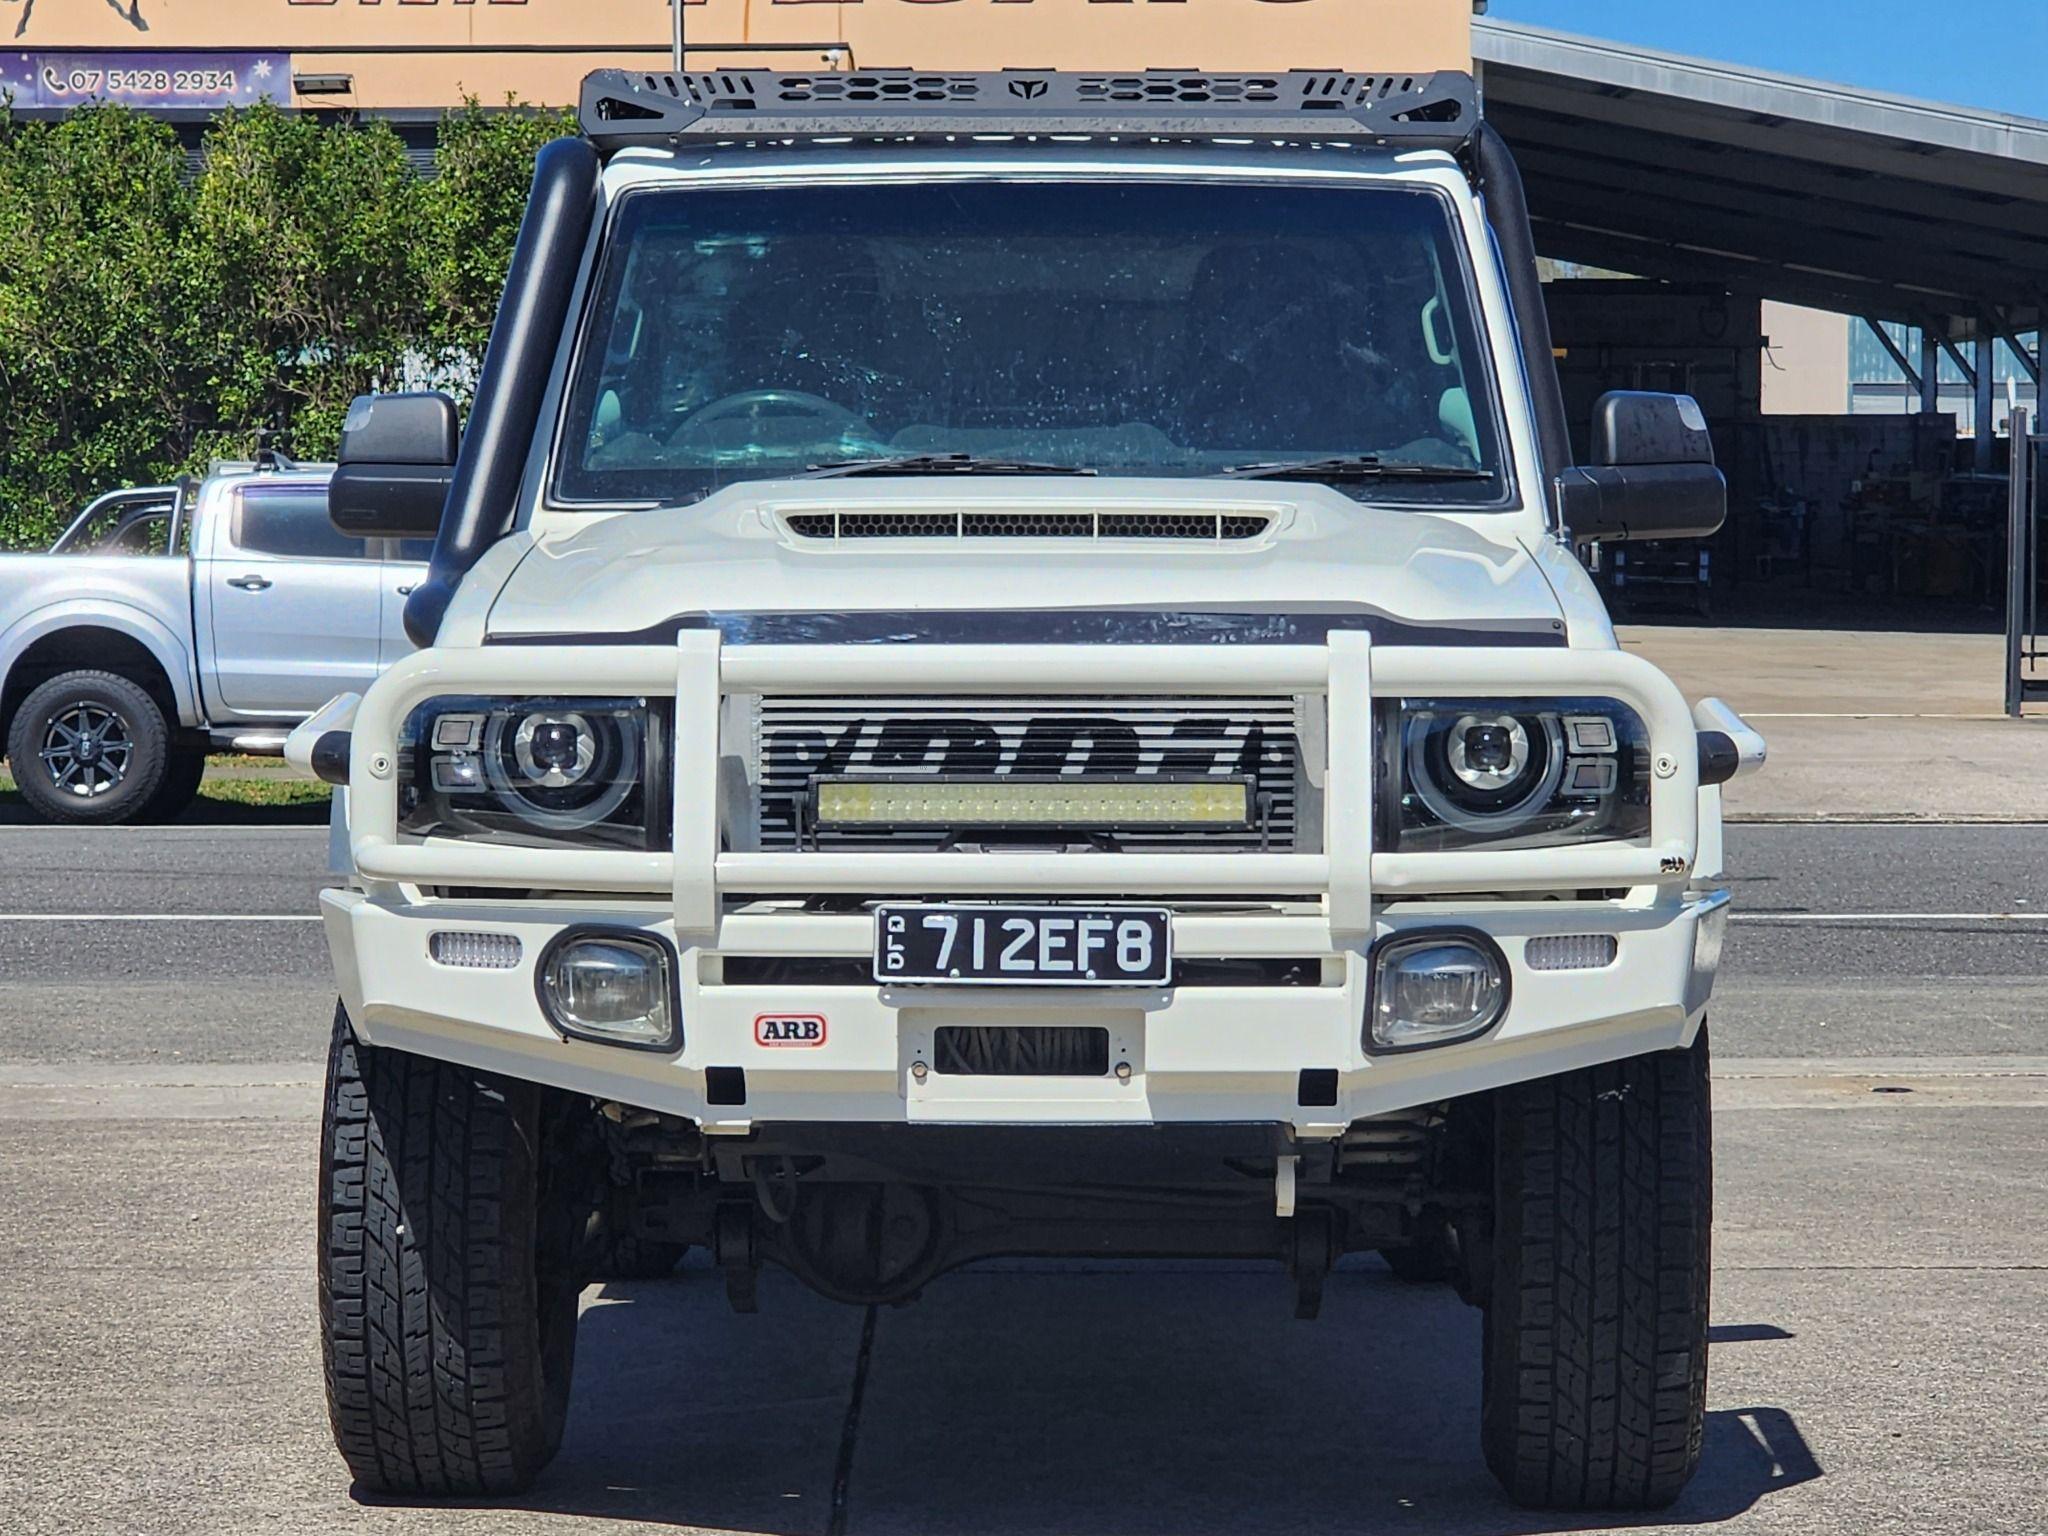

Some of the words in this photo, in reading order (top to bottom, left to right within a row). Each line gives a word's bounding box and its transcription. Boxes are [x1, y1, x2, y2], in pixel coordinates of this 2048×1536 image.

[70, 72, 100, 91] 07
[108, 72, 168, 91] 5428
[175, 72, 235, 91] 2934
[886, 916, 906, 970] QLD
[922, 915, 1153, 972] 712EF8
[762, 1020, 820, 1040] ARB
